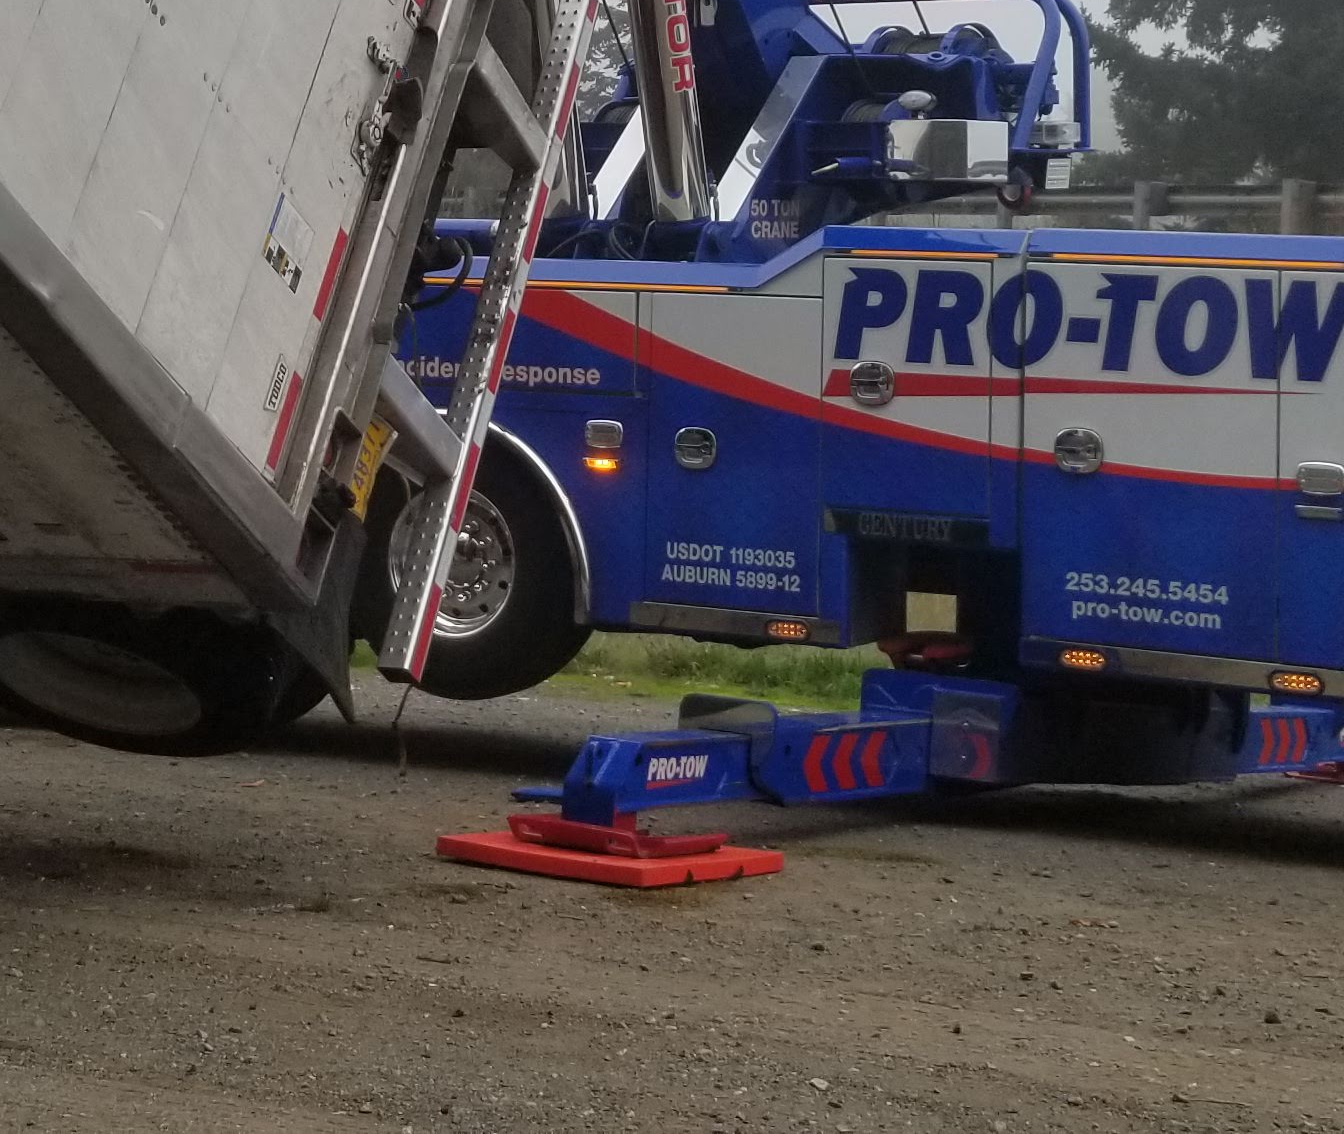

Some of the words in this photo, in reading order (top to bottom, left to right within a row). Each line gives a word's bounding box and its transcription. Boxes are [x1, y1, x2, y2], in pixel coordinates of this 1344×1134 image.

[751, 199, 768, 217] 50
[771, 199, 800, 217] TON
[751, 220, 800, 239] CRANE
[268, 362, 287, 409] TODCO
[503, 364, 601, 386] esponse
[666, 541, 724, 563] USDOT
[730, 547, 795, 569] 1193035
[661, 564, 731, 586] AUBURN
[735, 570, 801, 592] 5899-12
[1065, 571, 1229, 605] 253.245.5454
[1072, 600, 1222, 629] pro-tow.com
[647, 754, 709, 781] PRO-TOW
